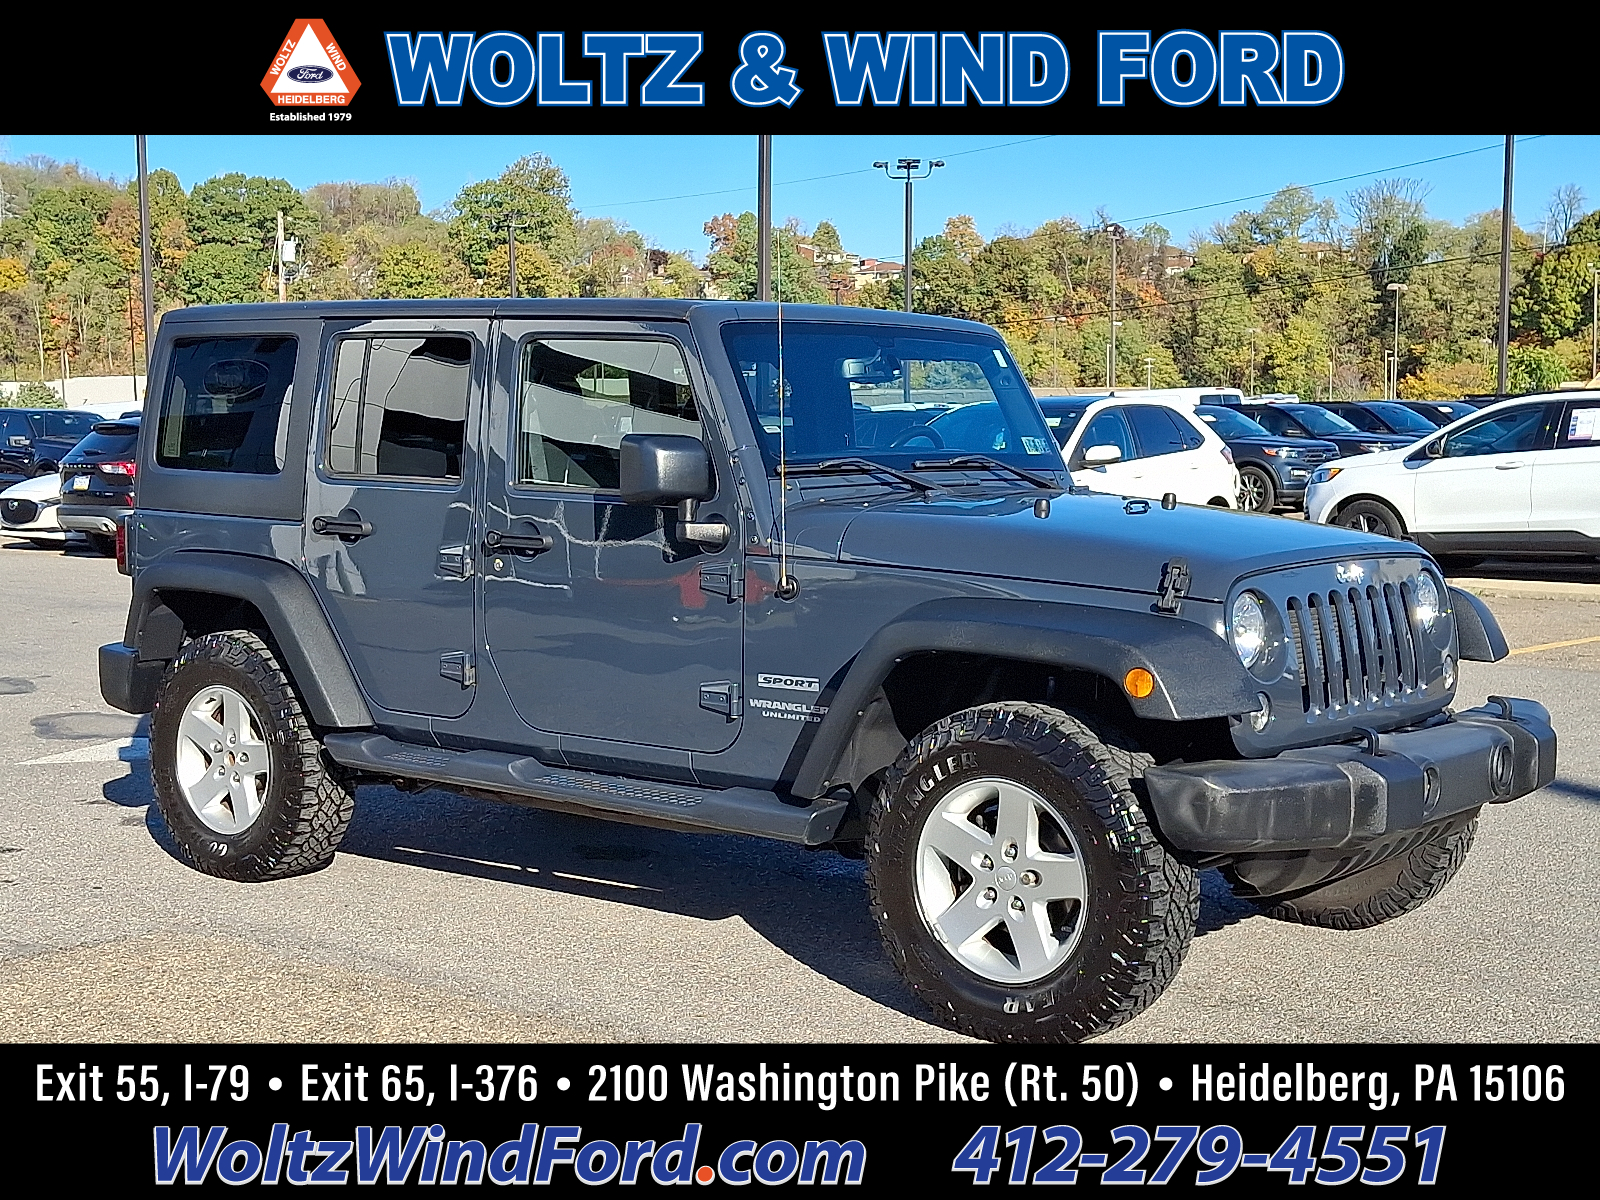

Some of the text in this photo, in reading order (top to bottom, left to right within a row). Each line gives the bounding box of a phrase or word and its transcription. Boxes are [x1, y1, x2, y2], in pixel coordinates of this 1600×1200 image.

[762, 676, 815, 689] SPORT
[749, 698, 830, 715] WRANGLER
[762, 711, 821, 723] UNLIMITED
